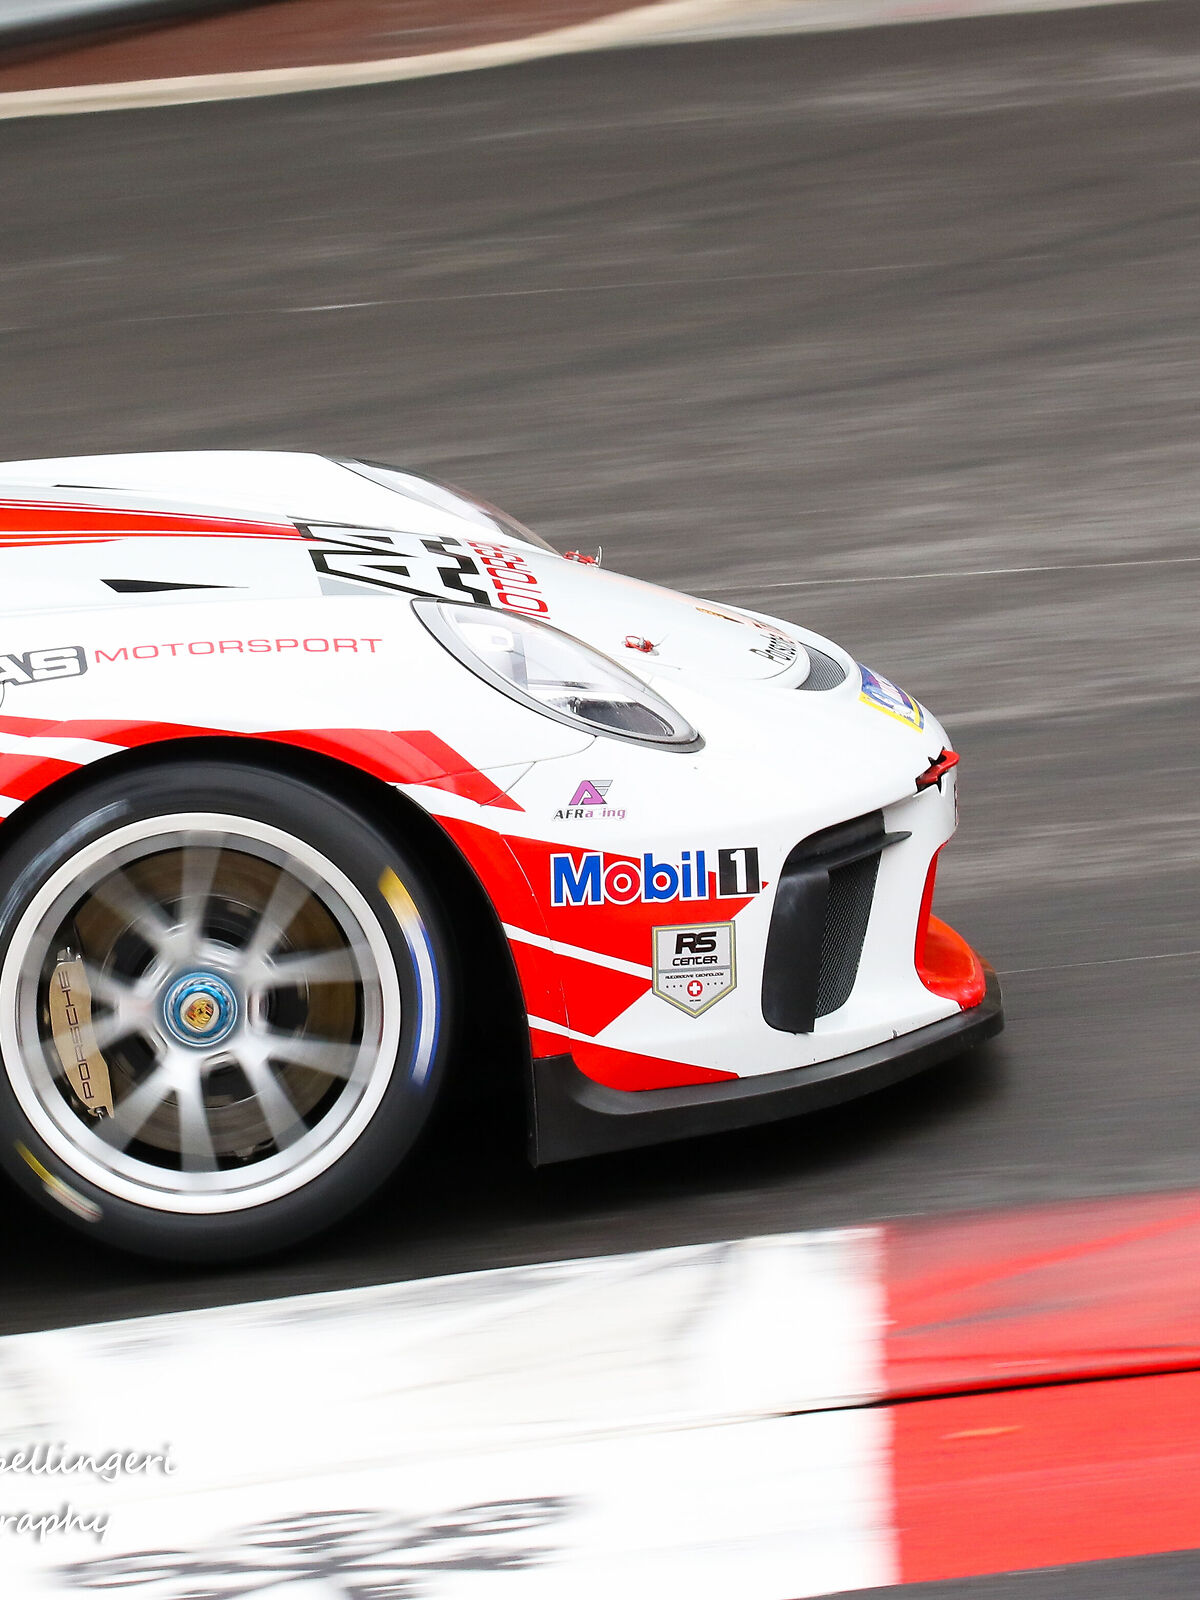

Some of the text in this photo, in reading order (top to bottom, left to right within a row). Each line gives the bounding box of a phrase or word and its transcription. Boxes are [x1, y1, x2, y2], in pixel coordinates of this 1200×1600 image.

[95, 638, 383, 664] MOTORSPORT
[553, 807, 626, 820] AFRaing
[551, 849, 707, 907] Mobil
[675, 931, 717, 954] RS
[672, 955, 718, 966] CENTER
[58, 970, 94, 1099] PORSCHE
